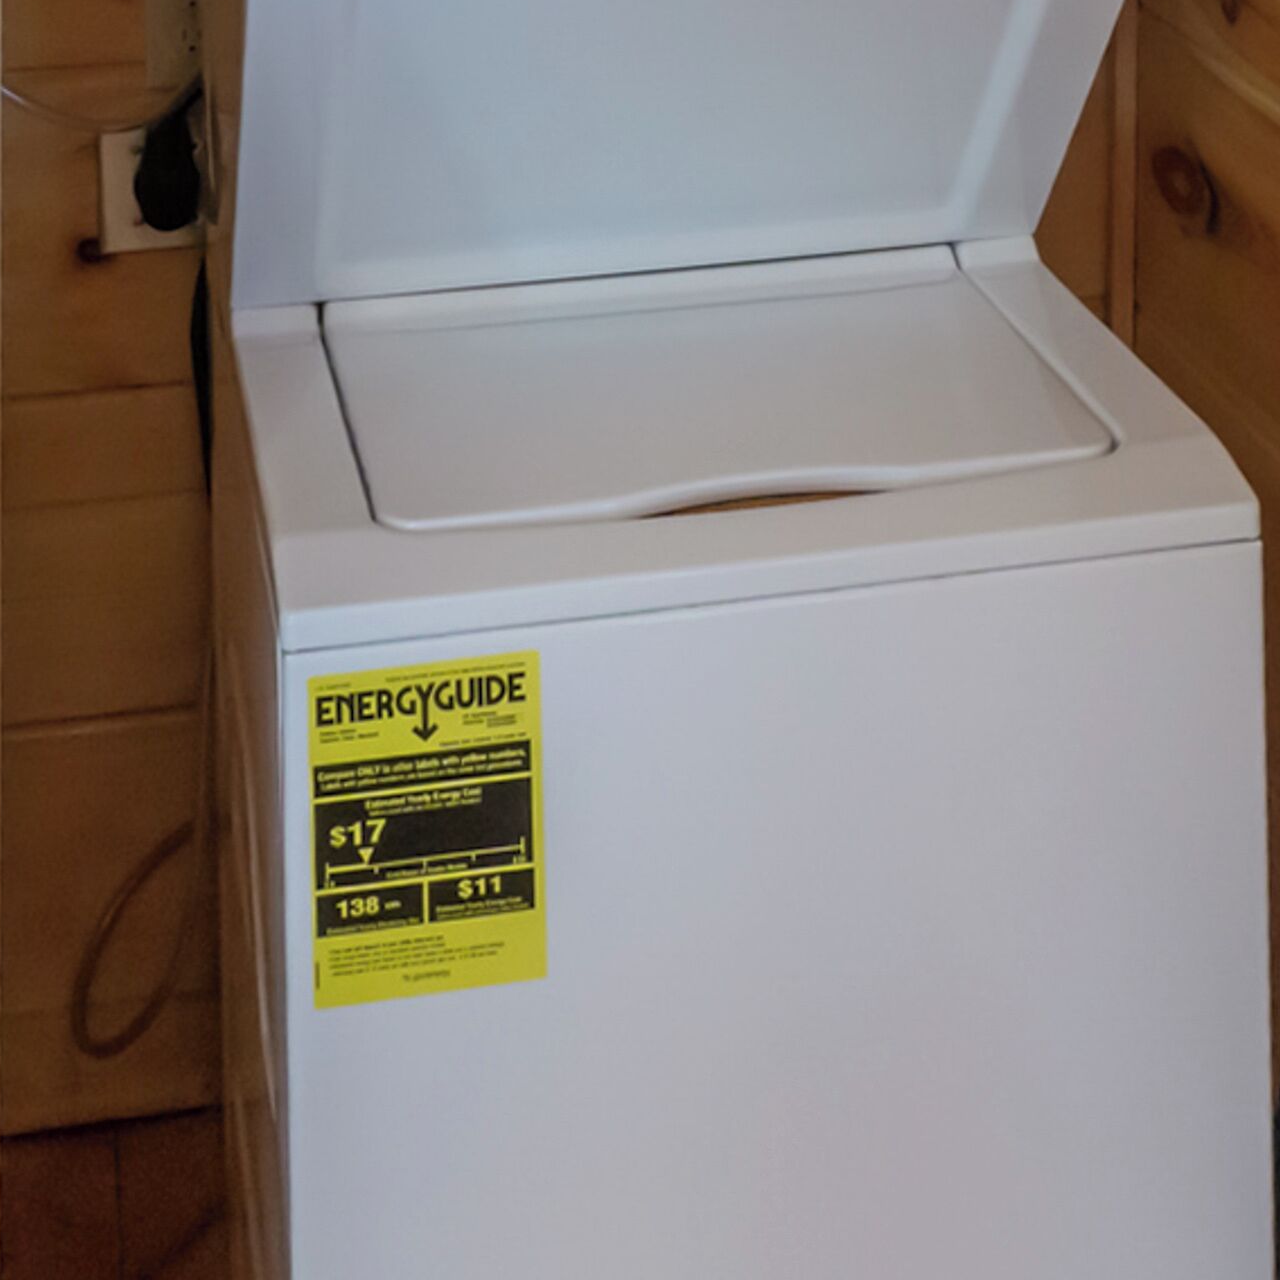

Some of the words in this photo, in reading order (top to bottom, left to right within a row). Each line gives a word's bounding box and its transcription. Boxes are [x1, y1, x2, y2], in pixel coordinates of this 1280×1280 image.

[316, 671, 526, 742] ENERGYGUIDE
[329, 818, 387, 848] $17
[457, 875, 503, 899] $11
[336, 895, 380, 919] 138
